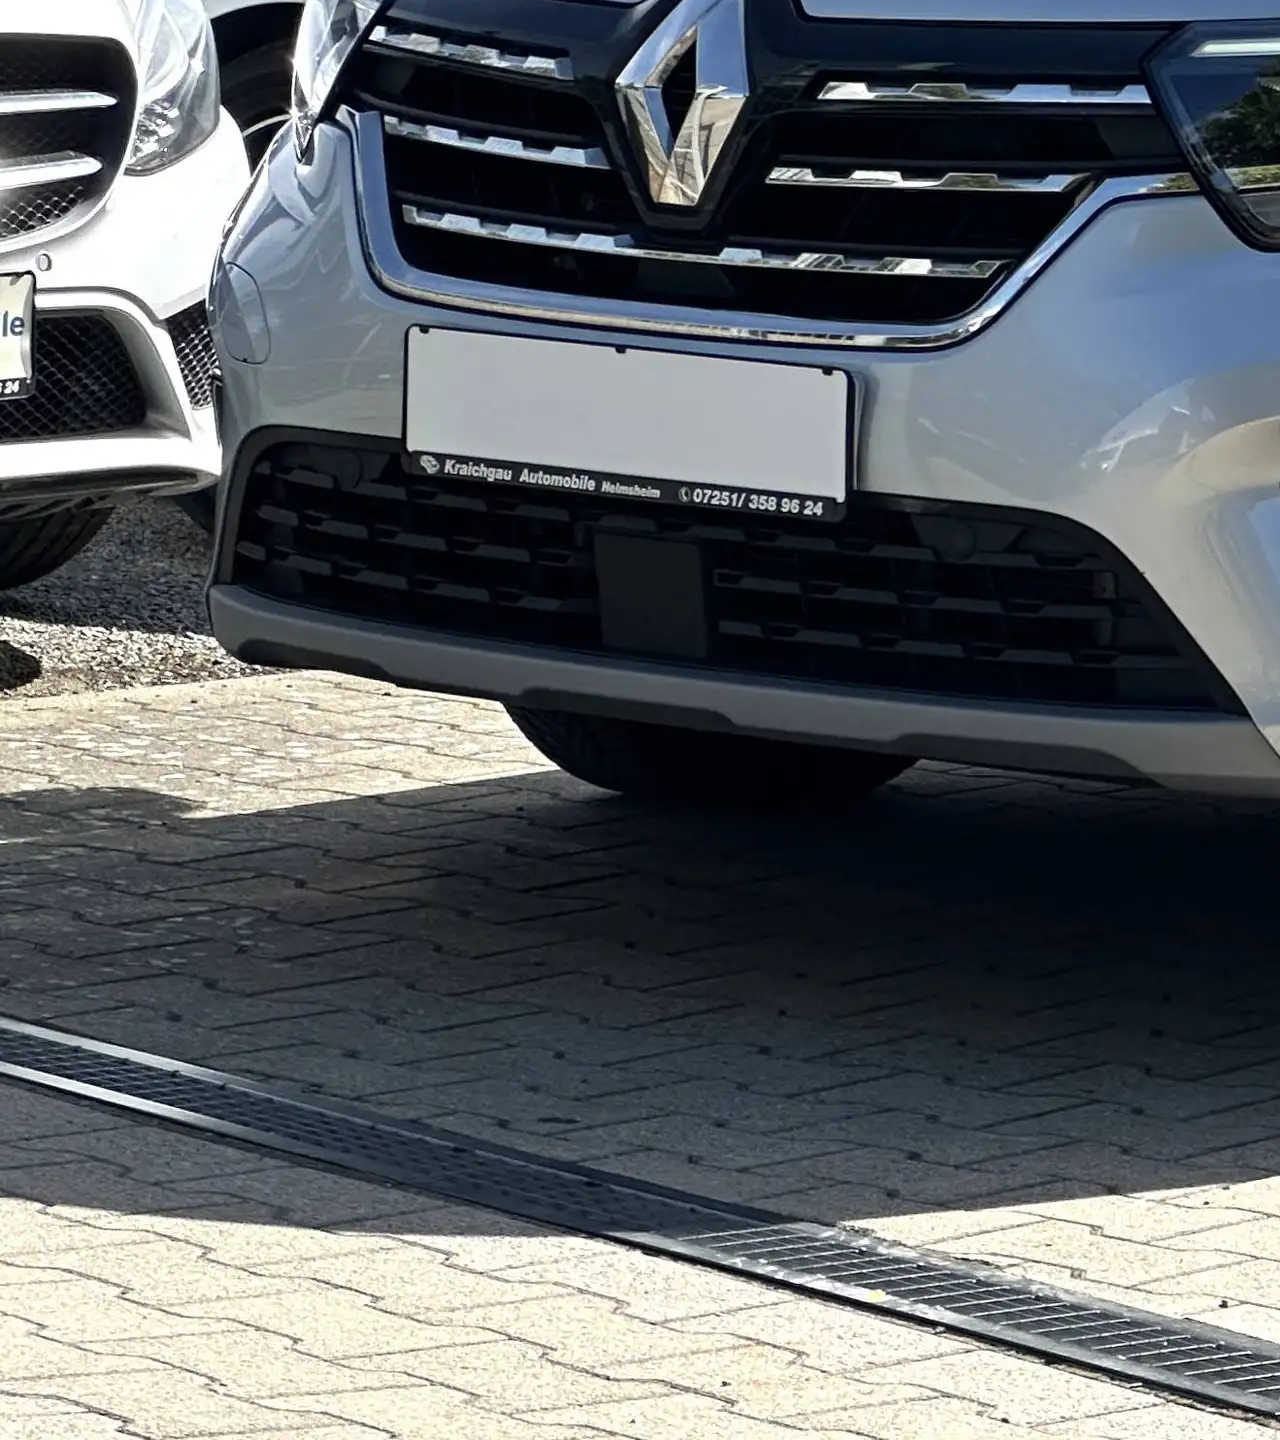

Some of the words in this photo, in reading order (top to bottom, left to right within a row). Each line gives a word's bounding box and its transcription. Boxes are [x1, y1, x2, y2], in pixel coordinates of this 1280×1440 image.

[443, 459, 512, 482] Kraichgau
[519, 467, 597, 492] Automobile
[601, 480, 661, 499] Helmsheim
[692, 489, 745, 510] 07251/
[748, 494, 777, 512] 358
[780, 498, 801, 514] 96
[803, 500, 824, 517] 24
